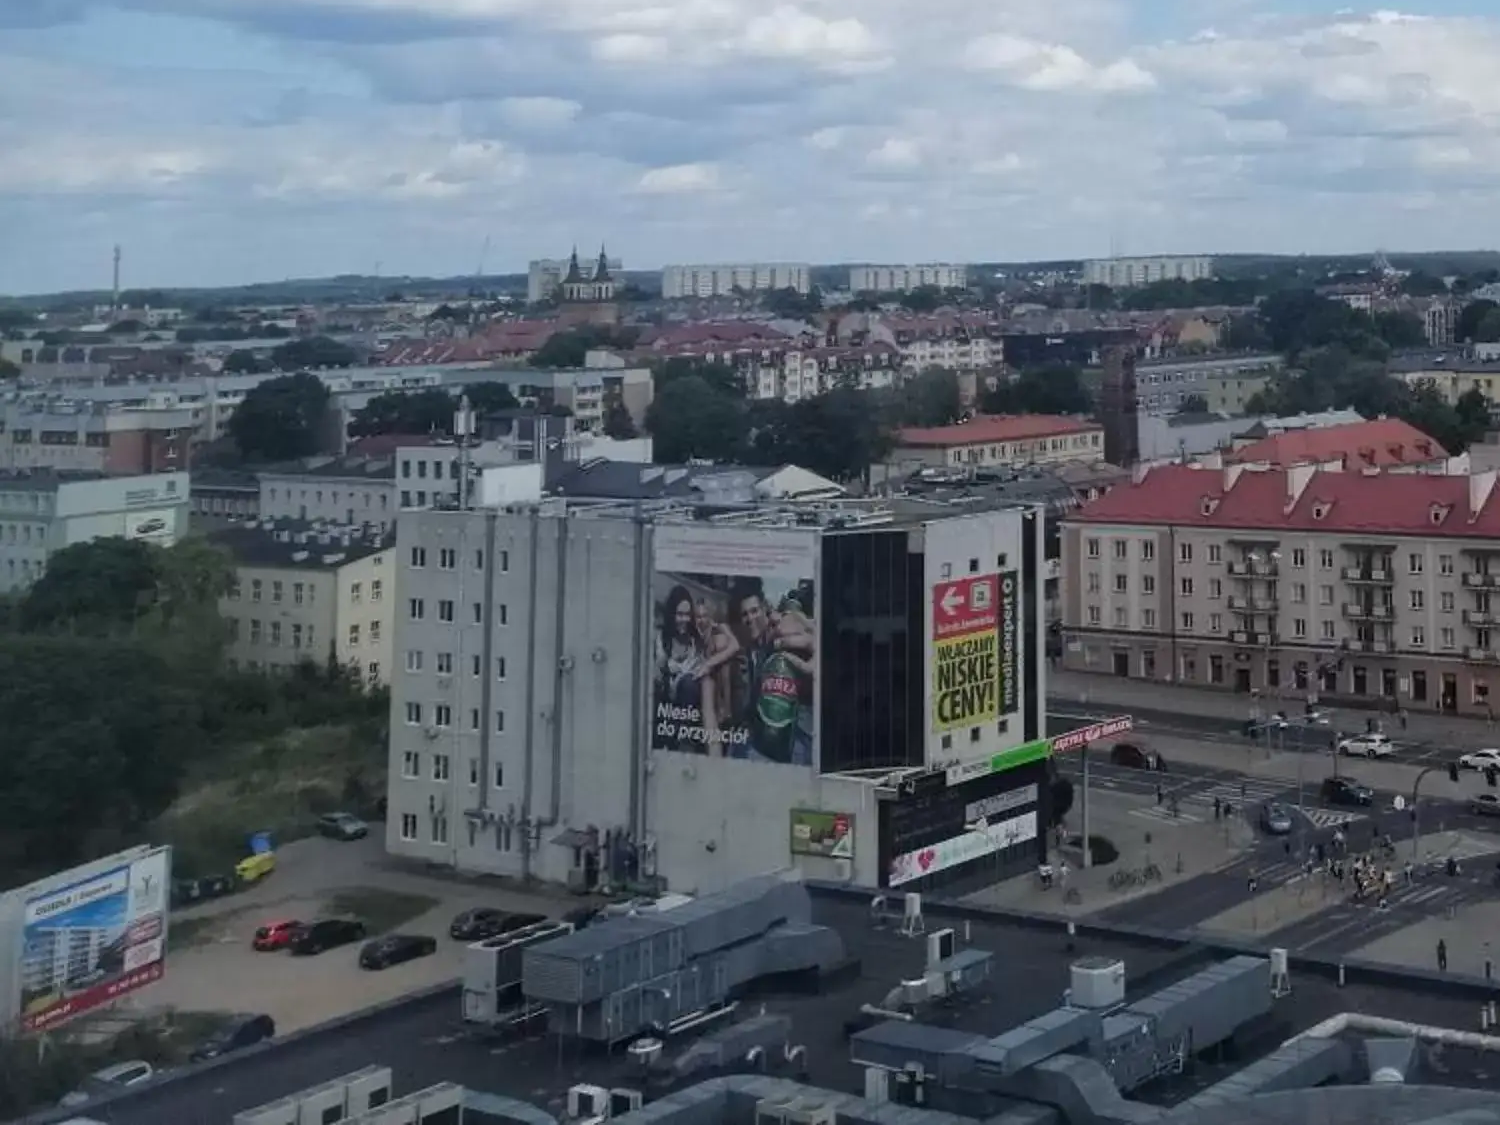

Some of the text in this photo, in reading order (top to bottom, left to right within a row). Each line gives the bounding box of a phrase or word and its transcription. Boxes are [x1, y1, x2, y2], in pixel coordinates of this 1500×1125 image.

[937, 652, 995, 691] NISKIE
[657, 702, 701, 722] Niesie
[937, 682, 995, 724] CENY!
[657, 720, 675, 736] do
